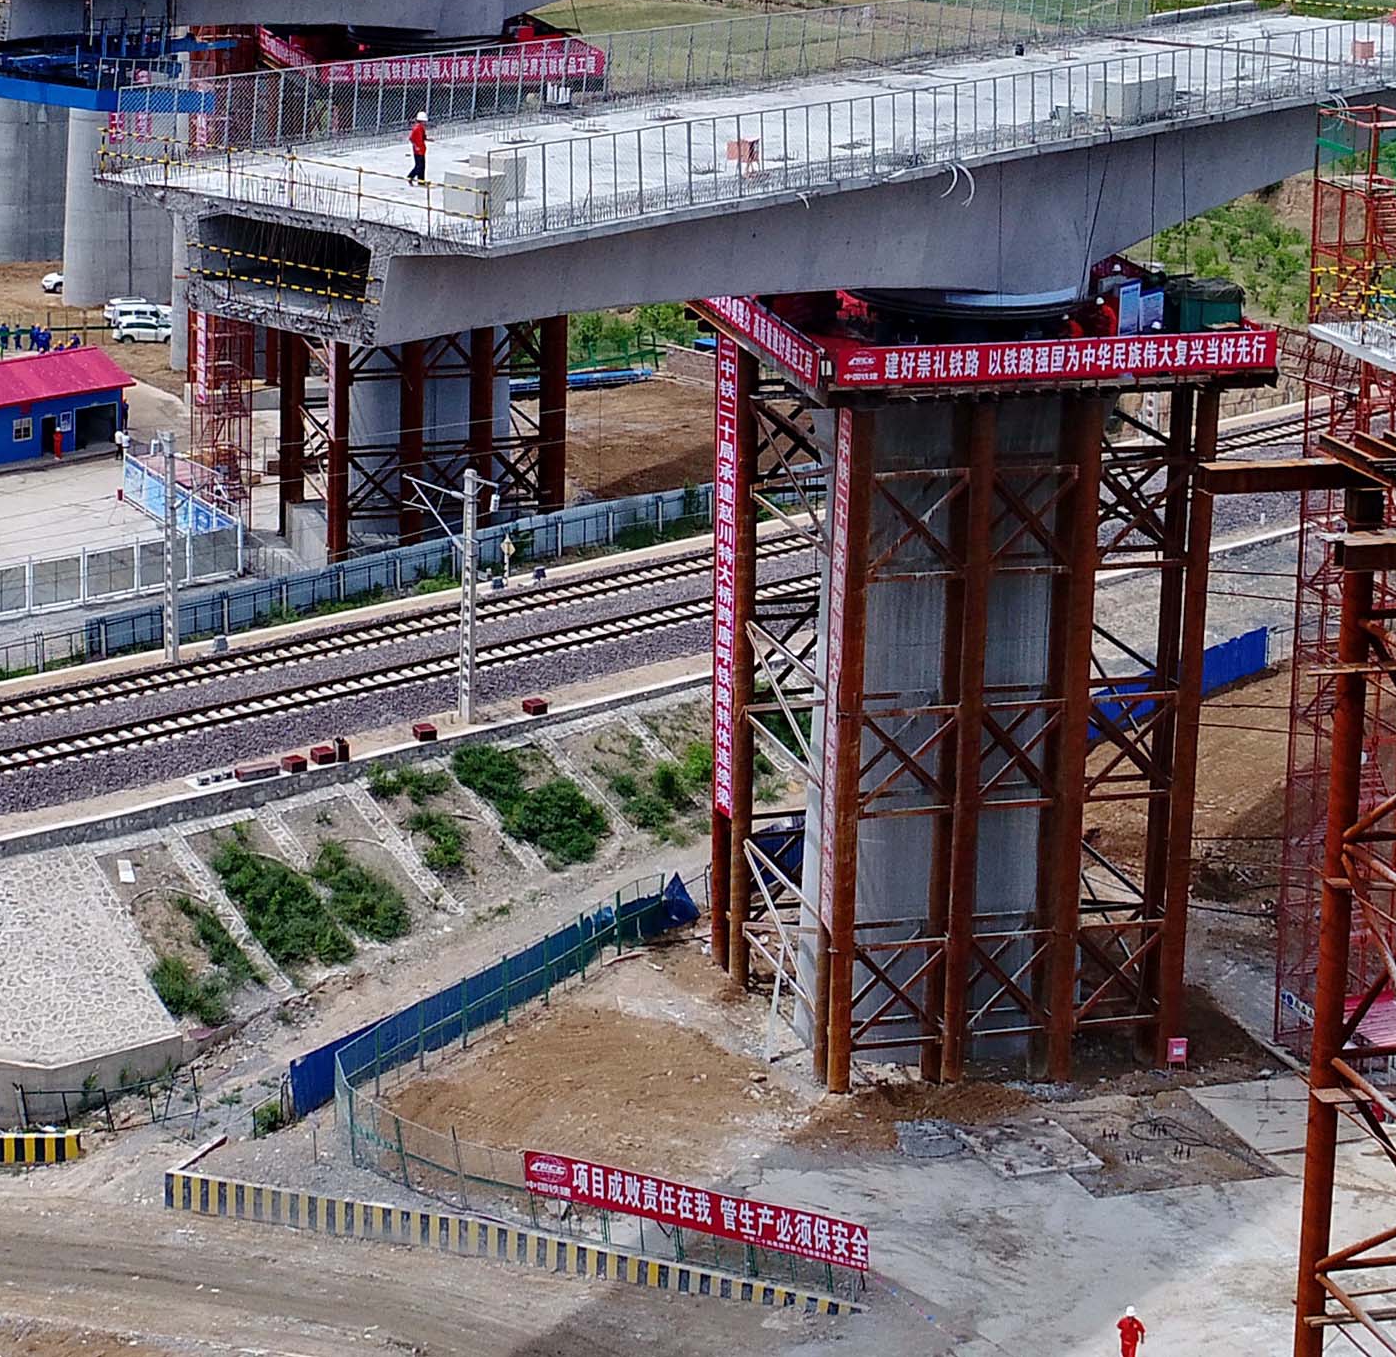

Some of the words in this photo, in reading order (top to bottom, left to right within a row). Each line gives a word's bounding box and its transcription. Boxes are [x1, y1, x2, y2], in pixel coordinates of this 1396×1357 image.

[884, 348, 980, 380] 建好崇礼铁路
[988, 335, 1267, 375] 以铁路强国为中华民族伟大复兴当好先行
[571, 1162, 712, 1226] 项目成败责任在我
[720, 1196, 869, 1262] 管生产必须保安全
